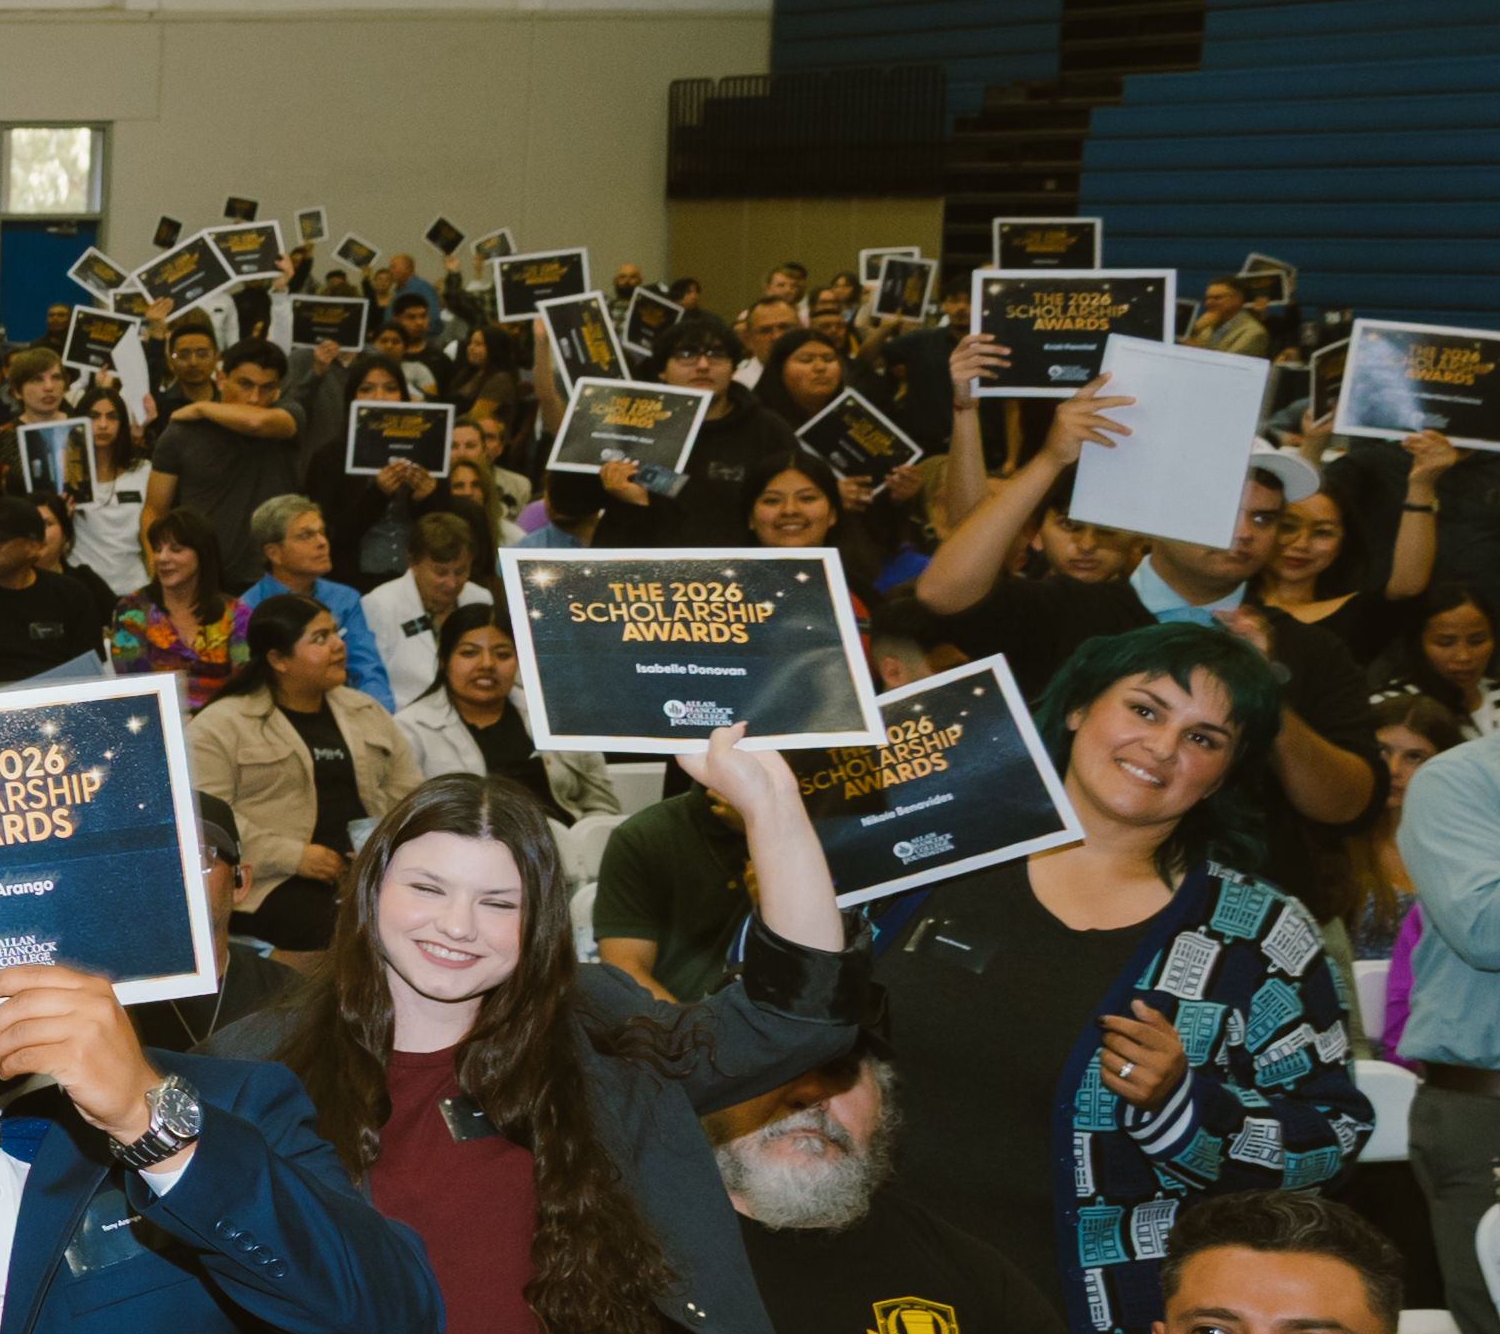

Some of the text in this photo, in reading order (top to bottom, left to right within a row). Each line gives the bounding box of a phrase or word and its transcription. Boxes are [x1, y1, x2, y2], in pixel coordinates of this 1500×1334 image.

[1033, 293, 1112, 306] THE 2026
[1006, 304, 1128, 318] SCHOLARSHIP
[1033, 318, 1110, 331] AWARDS
[608, 582, 743, 602] THE 2026
[569, 602, 773, 623] SCHOLARSHIP
[622, 622, 749, 644] AWARDS
[688, 664, 747, 676] Donovan
[801, 725, 963, 795] SCHOLARSHIP
[845, 752, 949, 800] AWARDS
